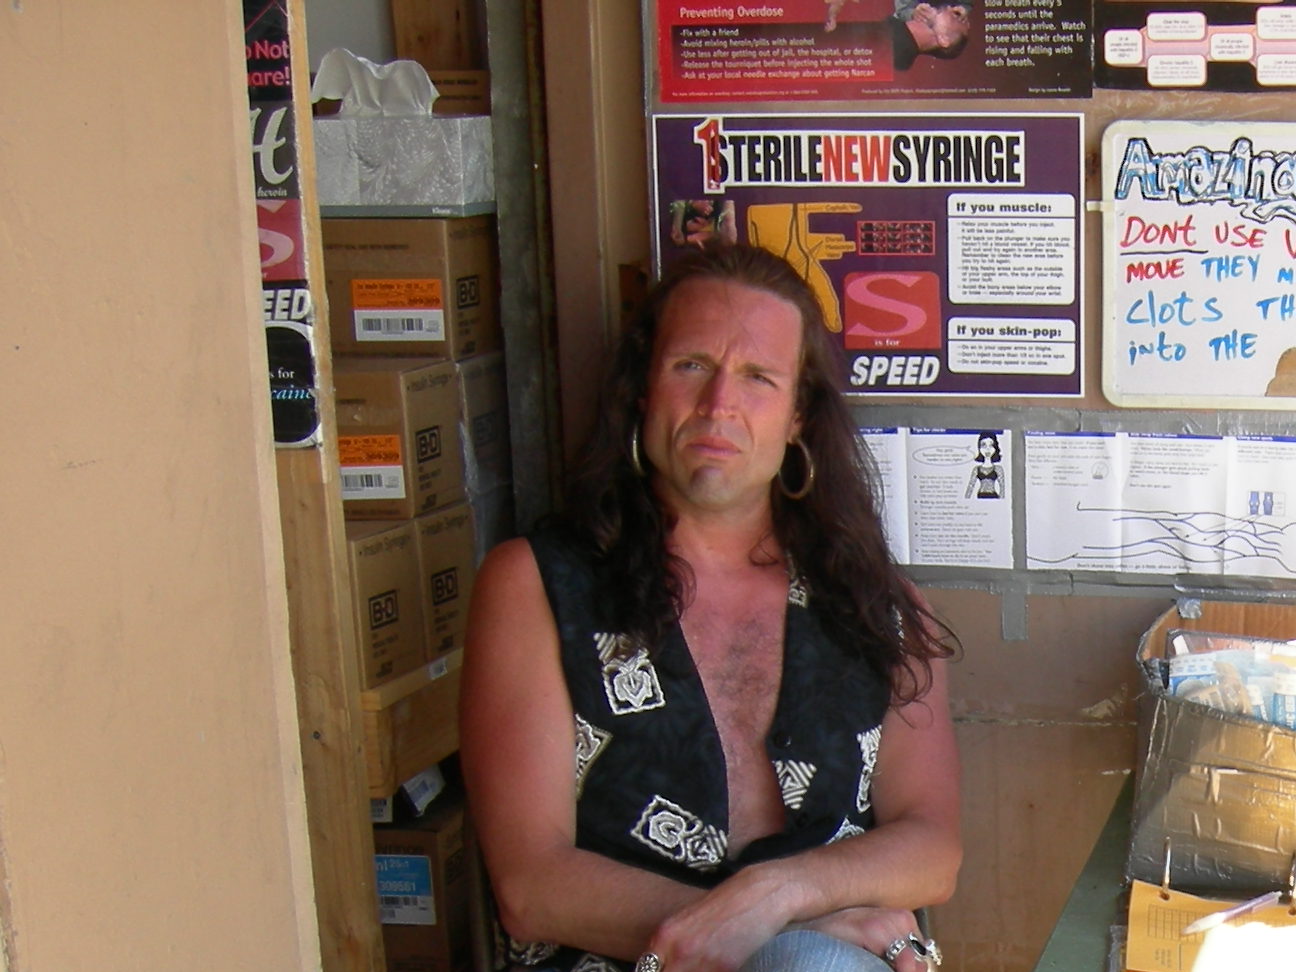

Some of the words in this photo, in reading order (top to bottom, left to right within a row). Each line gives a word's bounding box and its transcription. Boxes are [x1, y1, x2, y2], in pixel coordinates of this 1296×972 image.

[680, 7, 734, 20] Preventing
[737, 6, 784, 17] Overdose
[984, 10, 1016, 18] seconds
[1018, 9, 1037, 18] until
[1040, 9, 1054, 18] the
[695, 28, 710, 36] with
[718, 28, 739, 36] friend
[985, 21, 1029, 32] paramedics
[1030, 21, 1056, 30] arrive.
[1061, 21, 1086, 30] Watch
[704, 39, 728, 48] mixing
[772, 38, 787, 46] with
[789, 38, 815, 46] alcohol
[985, 34, 994, 42] to
[1012, 33, 1028, 42] that
[1030, 33, 1050, 42] their
[1052, 33, 1074, 42] chest
[1076, 32, 1084, 42] is
[254, 40, 289, 60] Not
[698, 50, 711, 58] less
[713, 49, 729, 58] after
[731, 50, 756, 58] getting
[772, 48, 780, 57] of
[798, 48, 809, 56] the
[852, 48, 872, 56] detox
[985, 46, 1008, 56] rising
[1010, 45, 1025, 54] and
[1027, 44, 1052, 56] falling
[1054, 44, 1072, 54] with
[712, 60, 724, 68] the
[725, 60, 762, 69] tourniquet
[763, 59, 785, 68] before
[820, 58, 832, 66] the
[834, 58, 854, 66] whole
[856, 58, 872, 66] shot
[985, 58, 1004, 67] each
[1006, 58, 1036, 67] breath.
[248, 66, 290, 86] are!
[698, 71, 706, 79] at
[707, 72, 722, 80] your
[724, 70, 742, 78] local
[743, 70, 766, 78] needle
[768, 70, 800, 79] exchange
[802, 69, 822, 78] about
[824, 69, 850, 79] getting
[851, 68, 876, 77] Narcan
[892, 135, 1022, 184] SYRINGE
[956, 202, 966, 212] If
[970, 204, 994, 214] you
[1000, 202, 1052, 212] muscle:
[1214, 224, 1267, 248] USE
[1126, 258, 1184, 283] MOVE
[1202, 256, 1261, 281] THEY
[263, 288, 311, 320] EED
[846, 274, 927, 337] S
[956, 325, 966, 335] If
[970, 326, 994, 337] you
[1000, 326, 1062, 338] skin-pop:
[1209, 329, 1258, 360] THE
[278, 366, 295, 378] for
[850, 356, 940, 386] SPEED
[271, 384, 312, 400] aine
